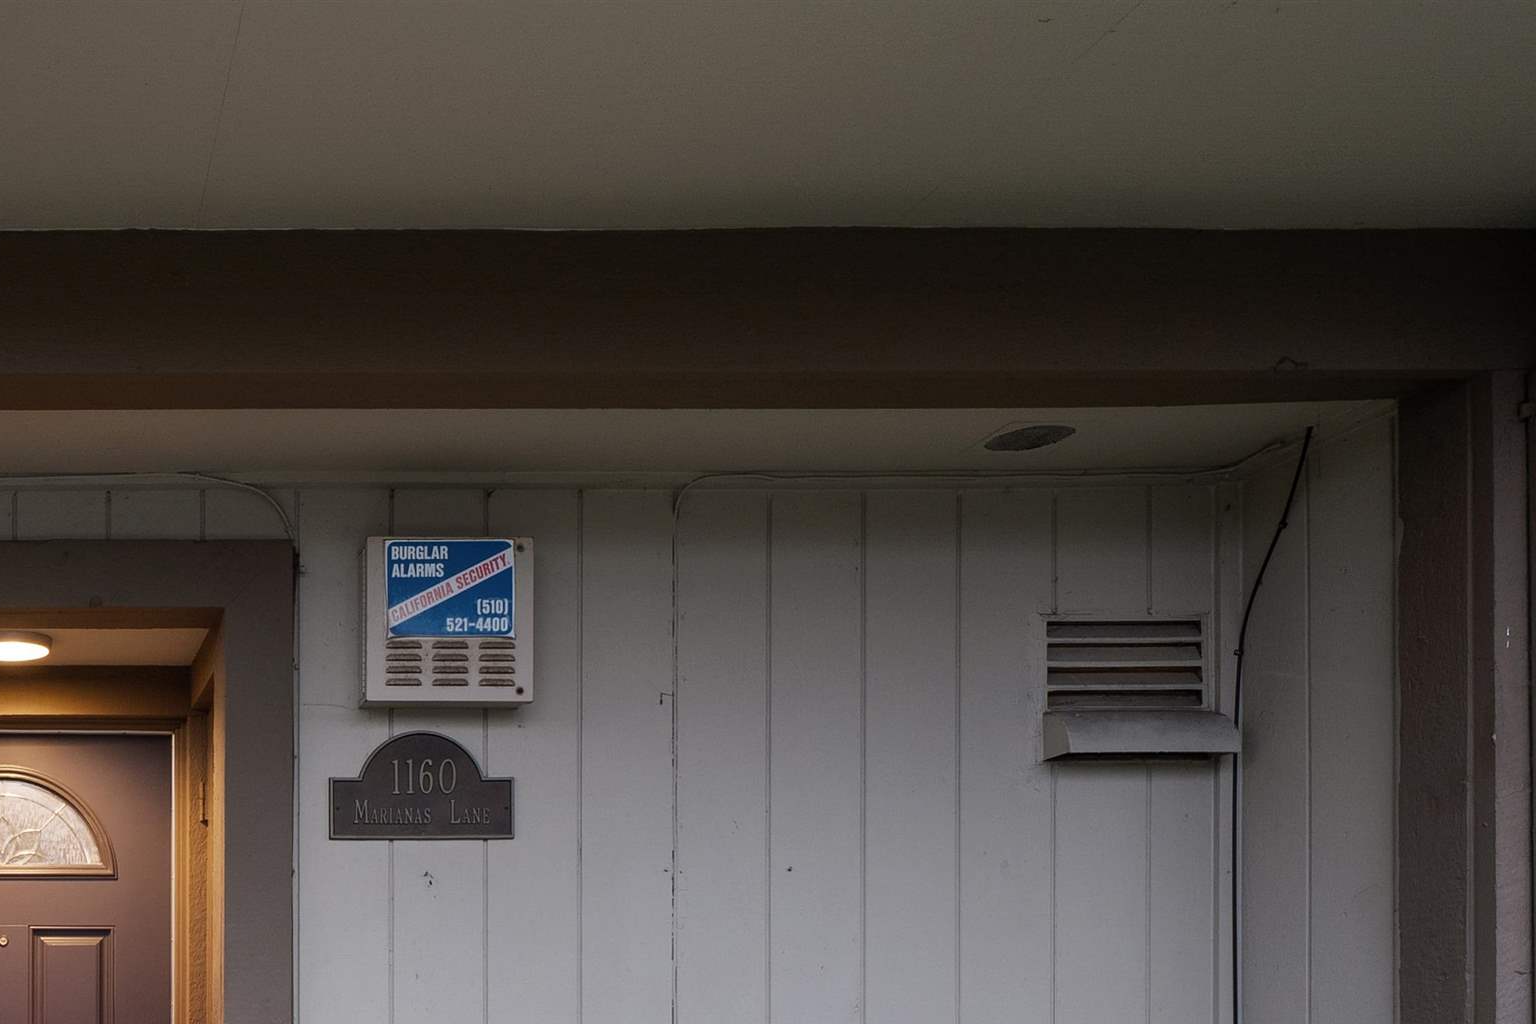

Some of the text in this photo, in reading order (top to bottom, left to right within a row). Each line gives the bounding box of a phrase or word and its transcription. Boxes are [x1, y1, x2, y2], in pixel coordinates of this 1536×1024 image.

[391, 546, 448, 560] BURGLAR
[392, 563, 444, 578] ALARMS
[392, 554, 507, 621] CALIFORNIA SECURITY
[477, 598, 508, 615] (510)
[446, 617, 508, 632] 521-4400
[392, 758, 457, 794] 1160
